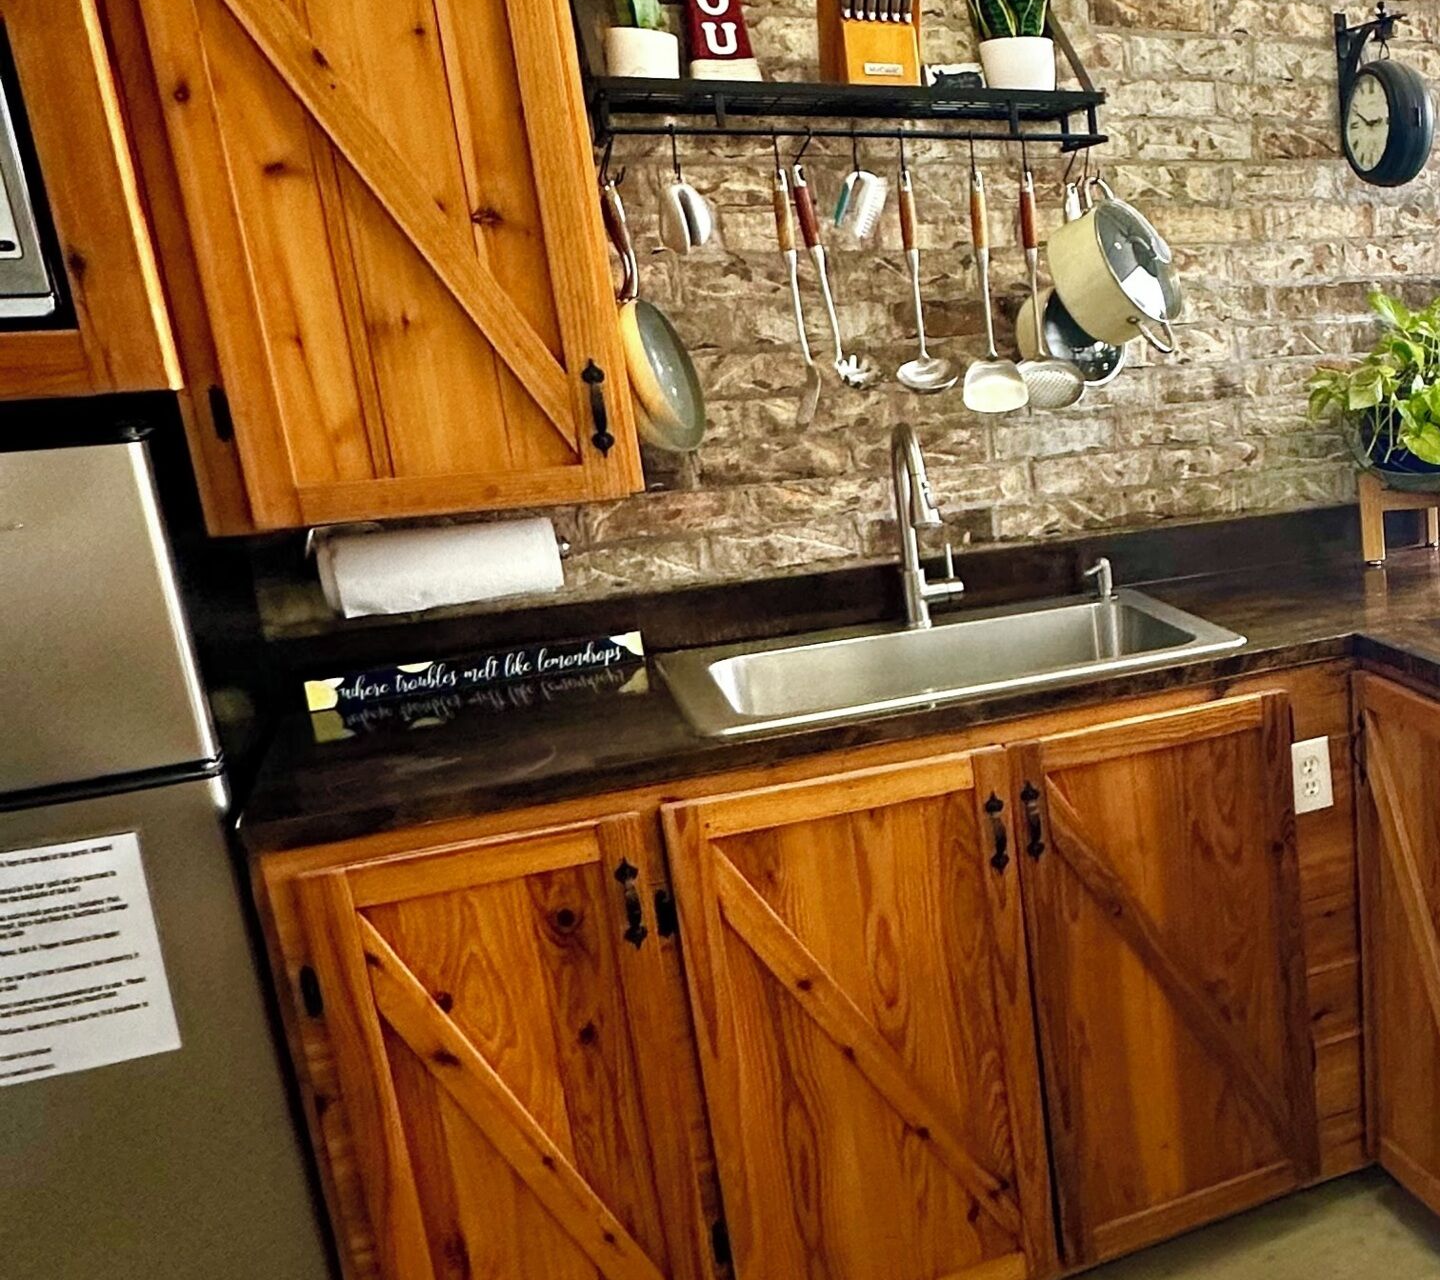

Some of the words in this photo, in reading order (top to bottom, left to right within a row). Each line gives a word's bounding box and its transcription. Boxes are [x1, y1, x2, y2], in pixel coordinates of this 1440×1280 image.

[339, 676, 390, 700] where
[395, 660, 458, 693] troubles
[463, 657, 498, 683] melt
[503, 654, 532, 678] like
[537, 641, 622, 671] lemondrops
